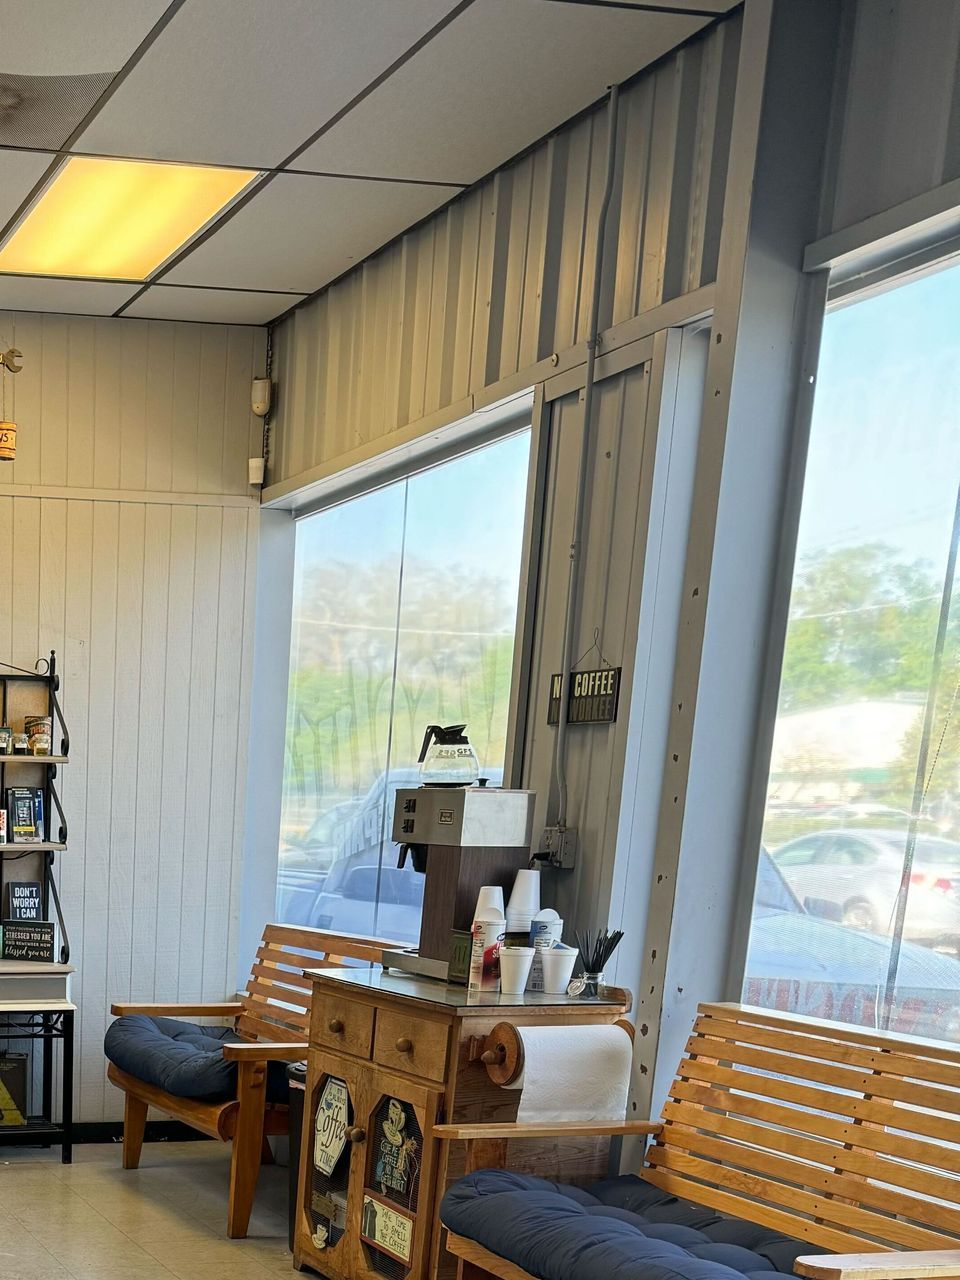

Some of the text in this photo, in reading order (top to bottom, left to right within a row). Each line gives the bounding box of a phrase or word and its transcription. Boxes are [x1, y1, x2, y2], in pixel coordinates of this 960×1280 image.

[574, 671, 615, 697] COFFEE
[14, 887, 37, 897] DON'T
[12, 897, 40, 908] WORRY
[21, 908, 37, 918] CAN
[6, 932, 30, 940] STRESSED
[5, 946, 28, 957] blessed
[28, 950, 39, 958] you
[315, 1104, 346, 1148] Coffee
[395, 1216, 407, 1231] TIME
[390, 1225, 407, 1242] SMELL
[389, 1235, 406, 1252] COFFEE
